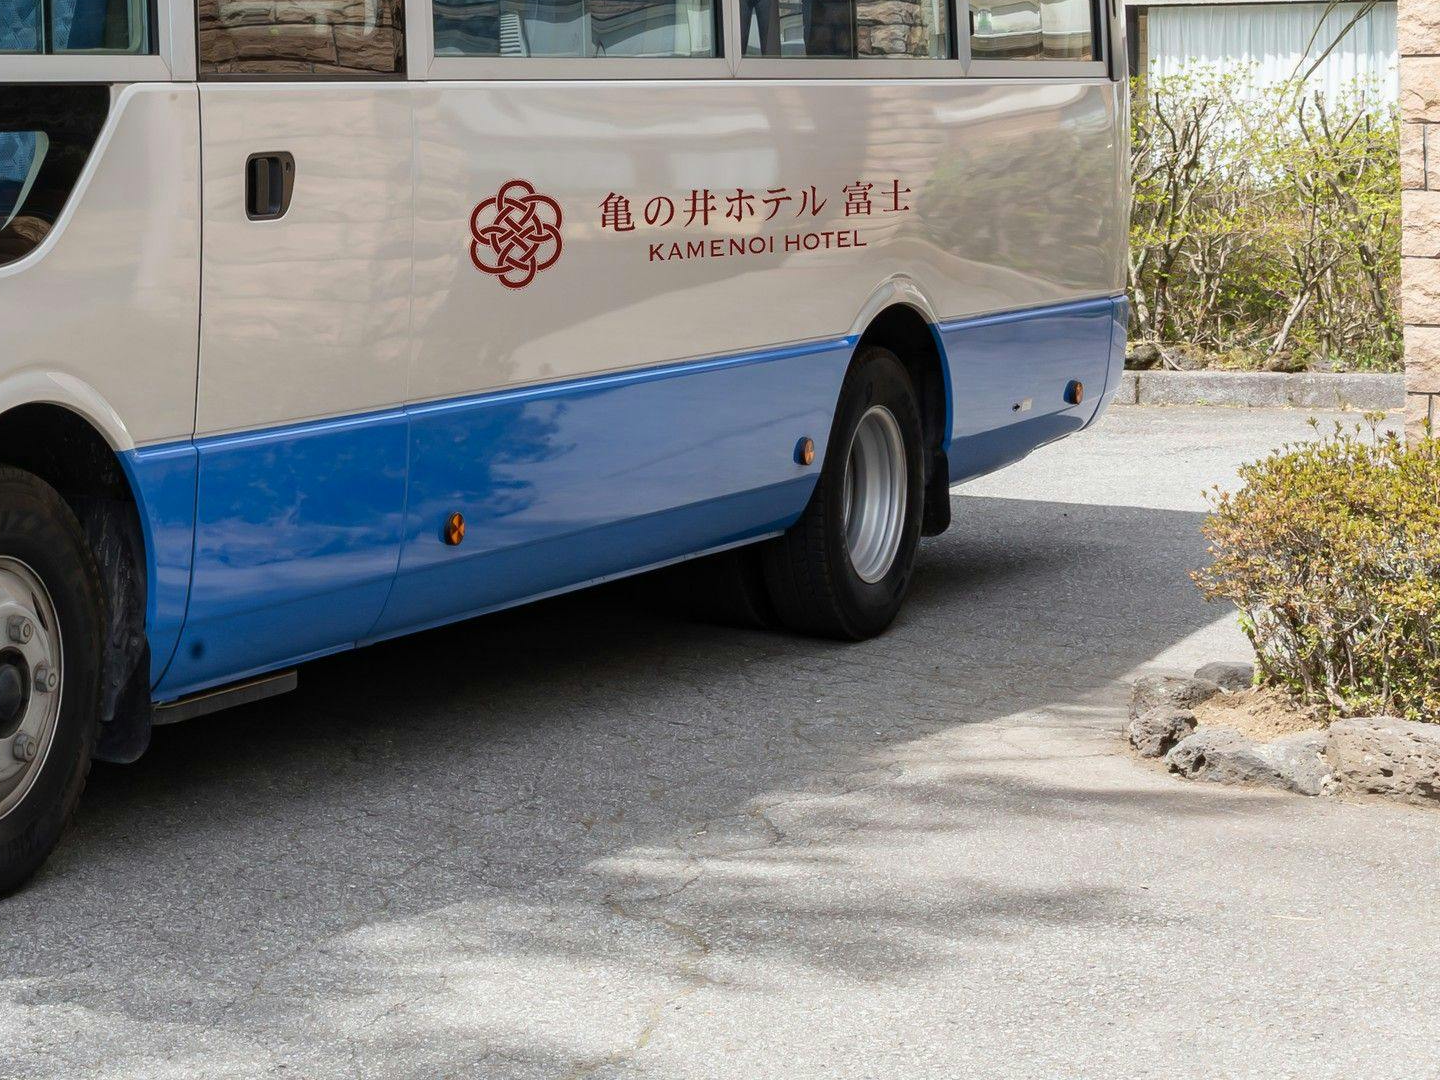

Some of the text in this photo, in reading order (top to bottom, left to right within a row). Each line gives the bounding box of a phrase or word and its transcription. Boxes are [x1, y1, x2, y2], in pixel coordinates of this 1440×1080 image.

[598, 179, 912, 232] 亀の井ホテル 富士
[648, 230, 868, 262] KAMENOI HOTEL
